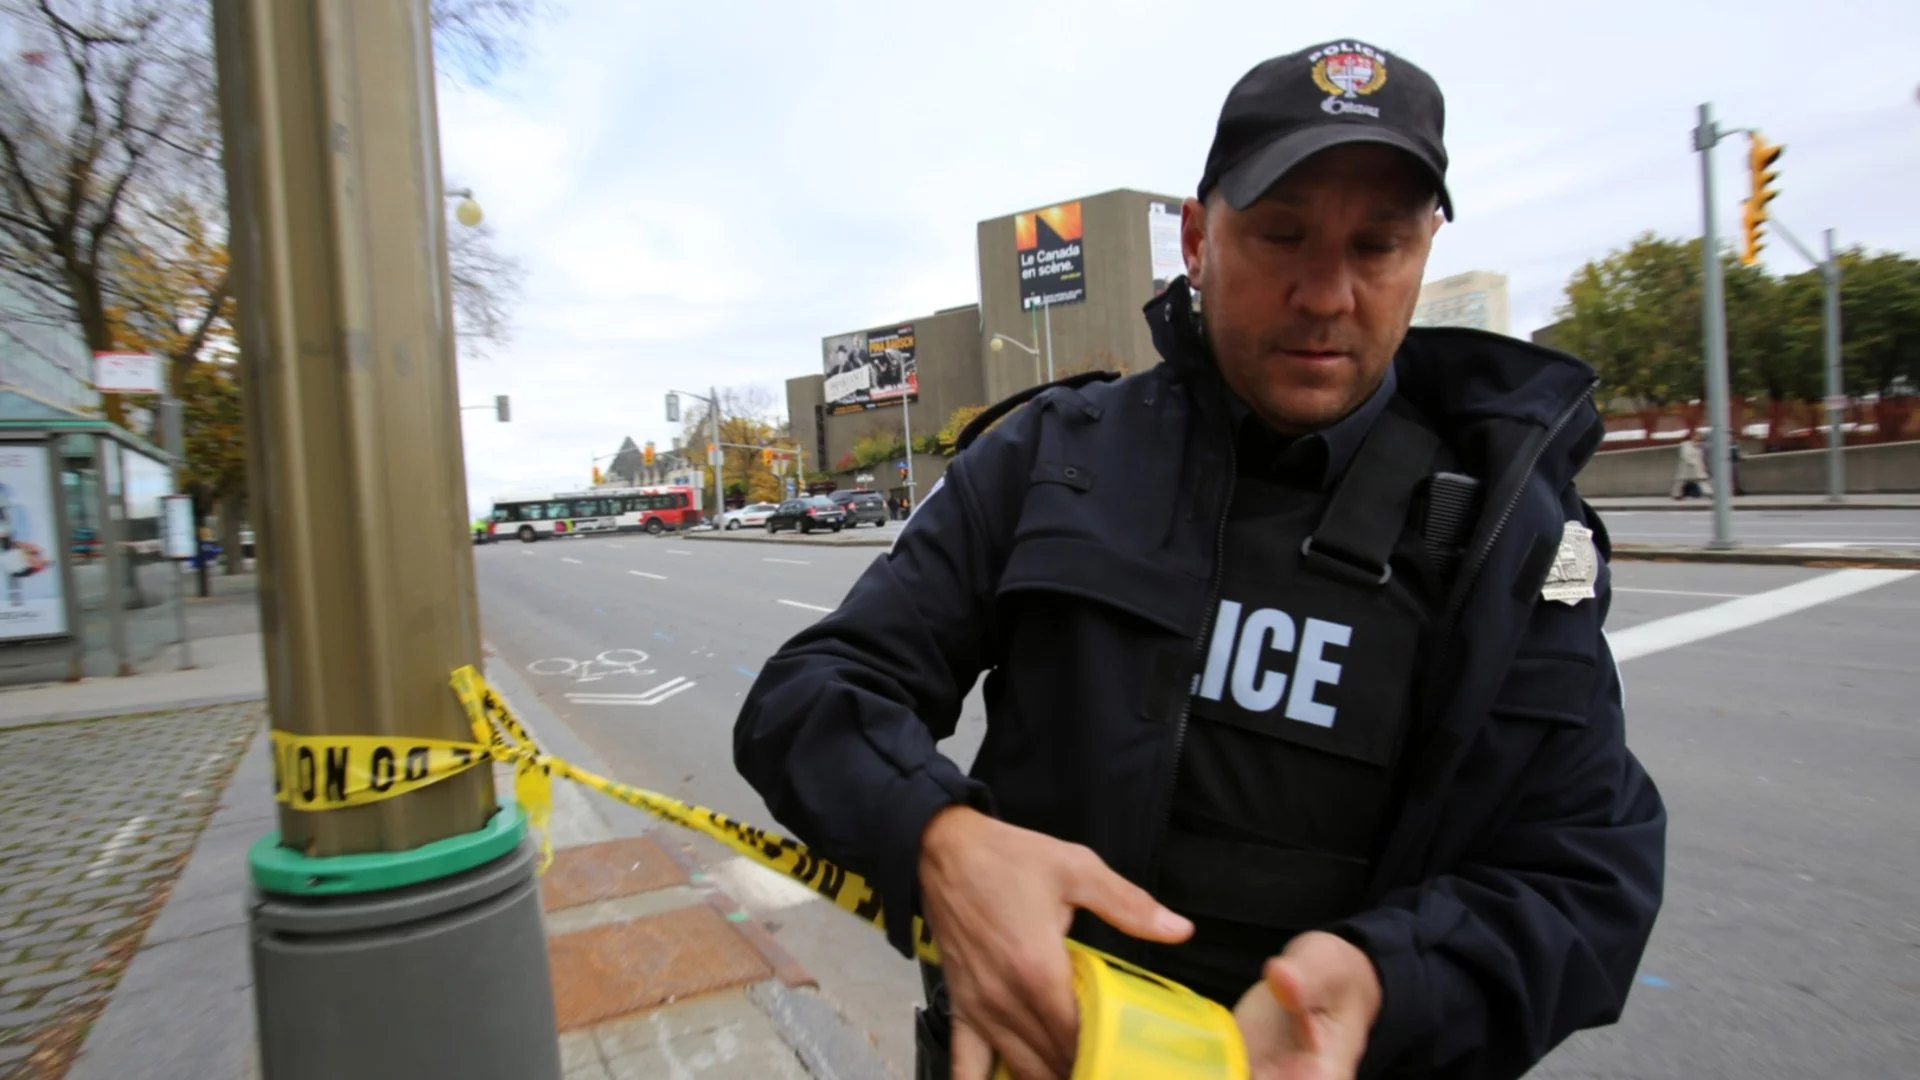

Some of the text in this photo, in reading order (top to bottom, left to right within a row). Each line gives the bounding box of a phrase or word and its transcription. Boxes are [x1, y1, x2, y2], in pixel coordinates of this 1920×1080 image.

[1308, 42, 1386, 66] POLICE
[1021, 243, 1080, 267] Le Canada
[1022, 268, 1036, 280] en
[1190, 599, 1353, 728] ICE
[371, 746, 430, 792] DO
